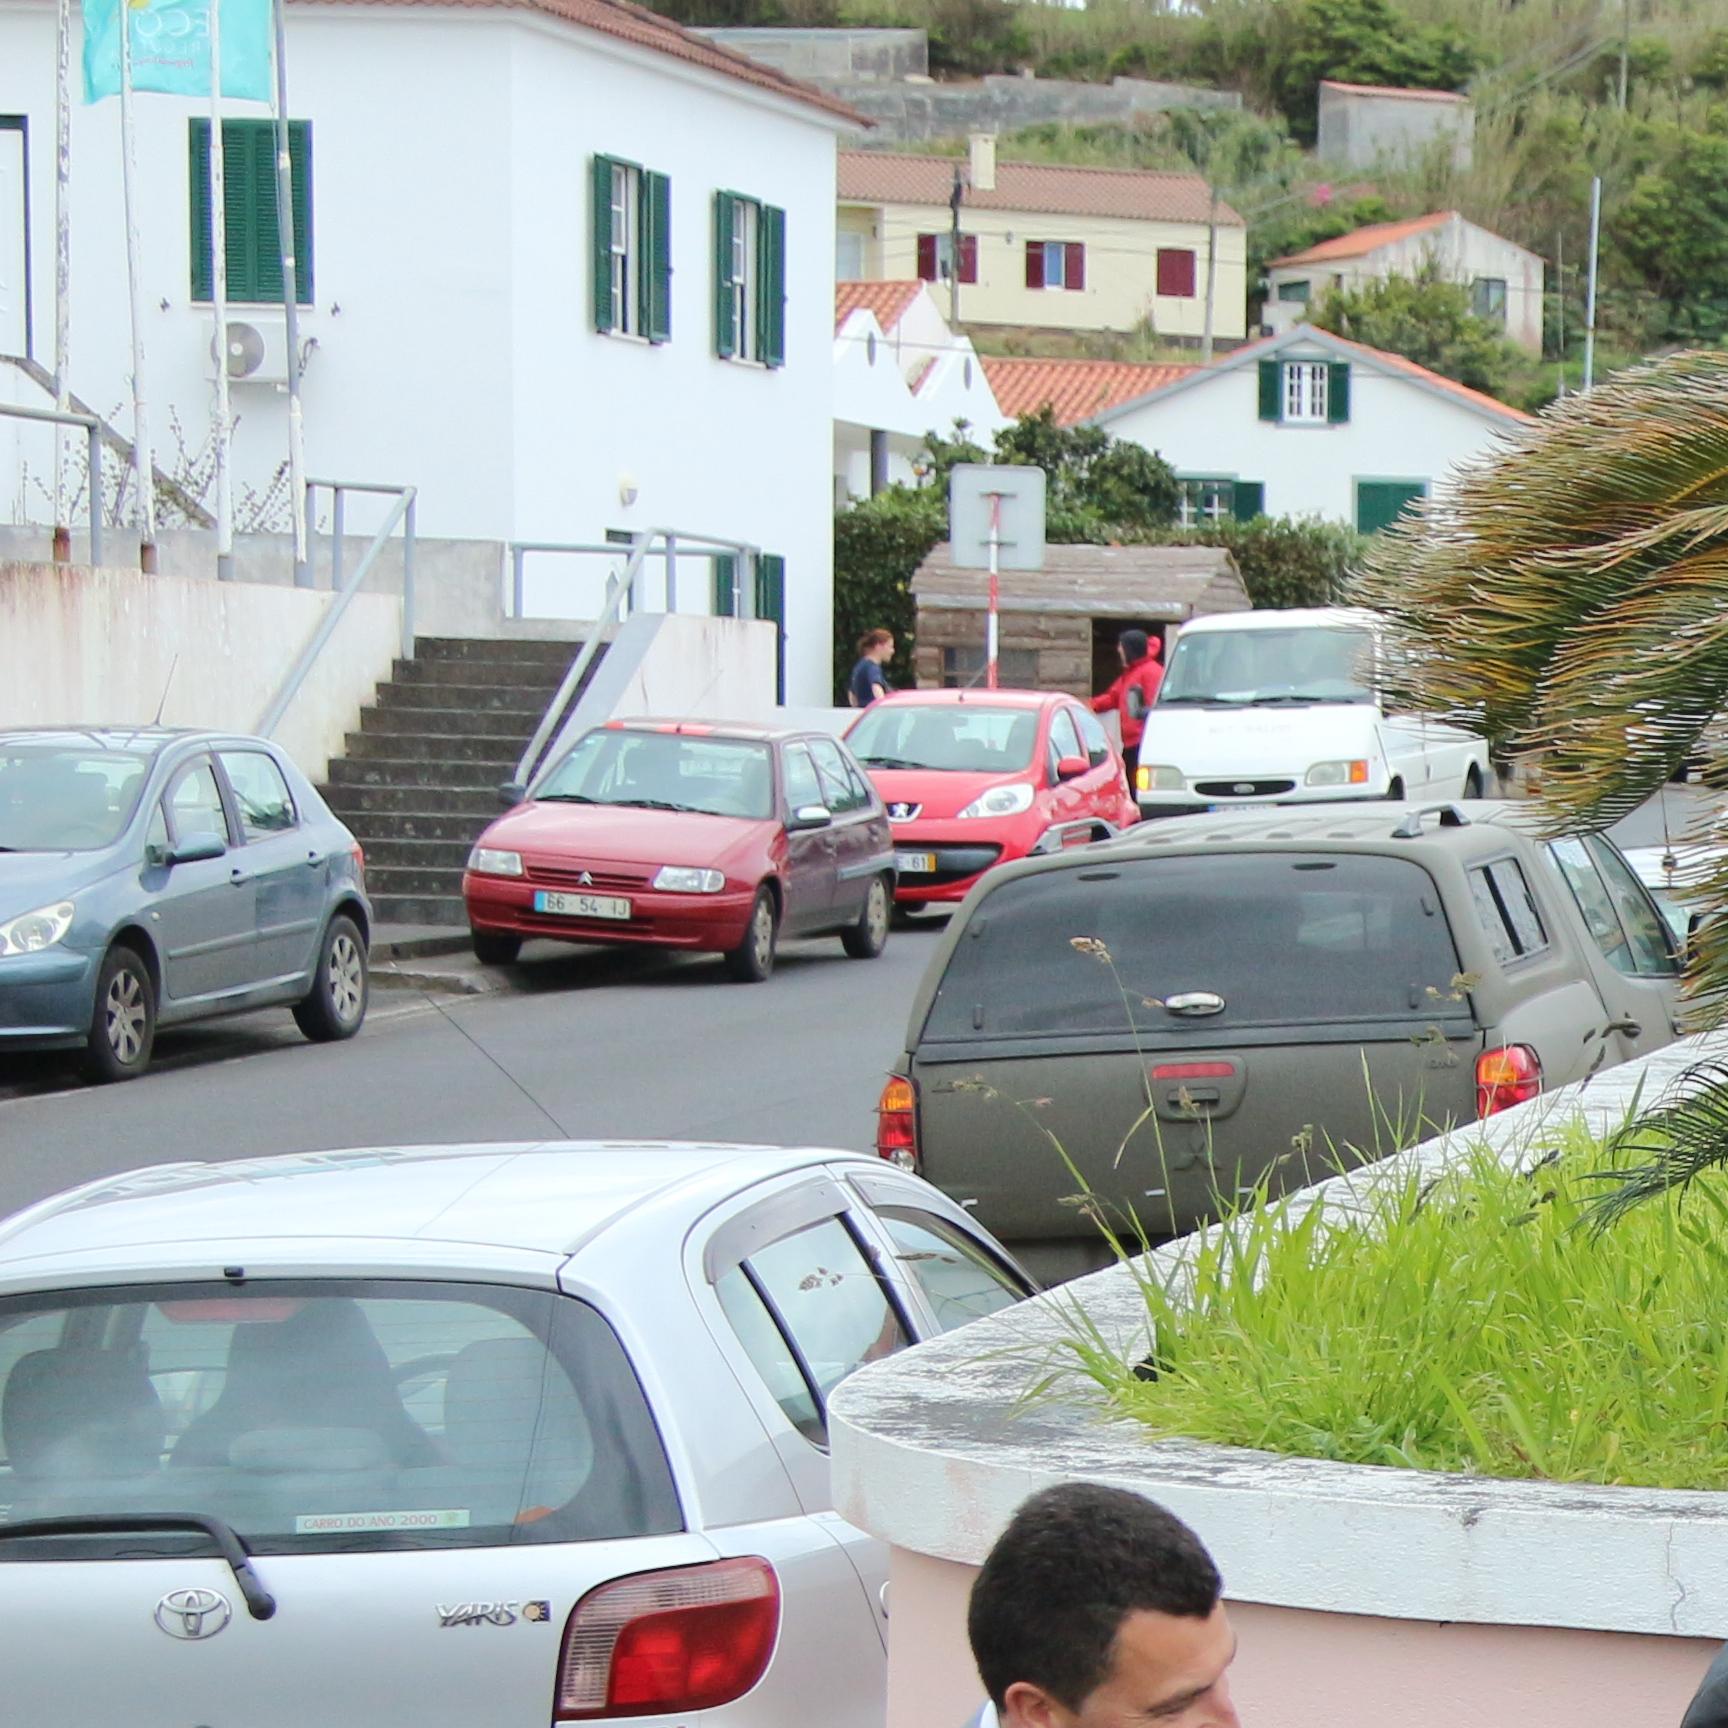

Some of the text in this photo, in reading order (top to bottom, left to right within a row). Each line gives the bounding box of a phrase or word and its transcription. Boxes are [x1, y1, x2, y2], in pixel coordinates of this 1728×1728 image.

[303, 1514, 437, 1530] CARRO DO ANO 2000
